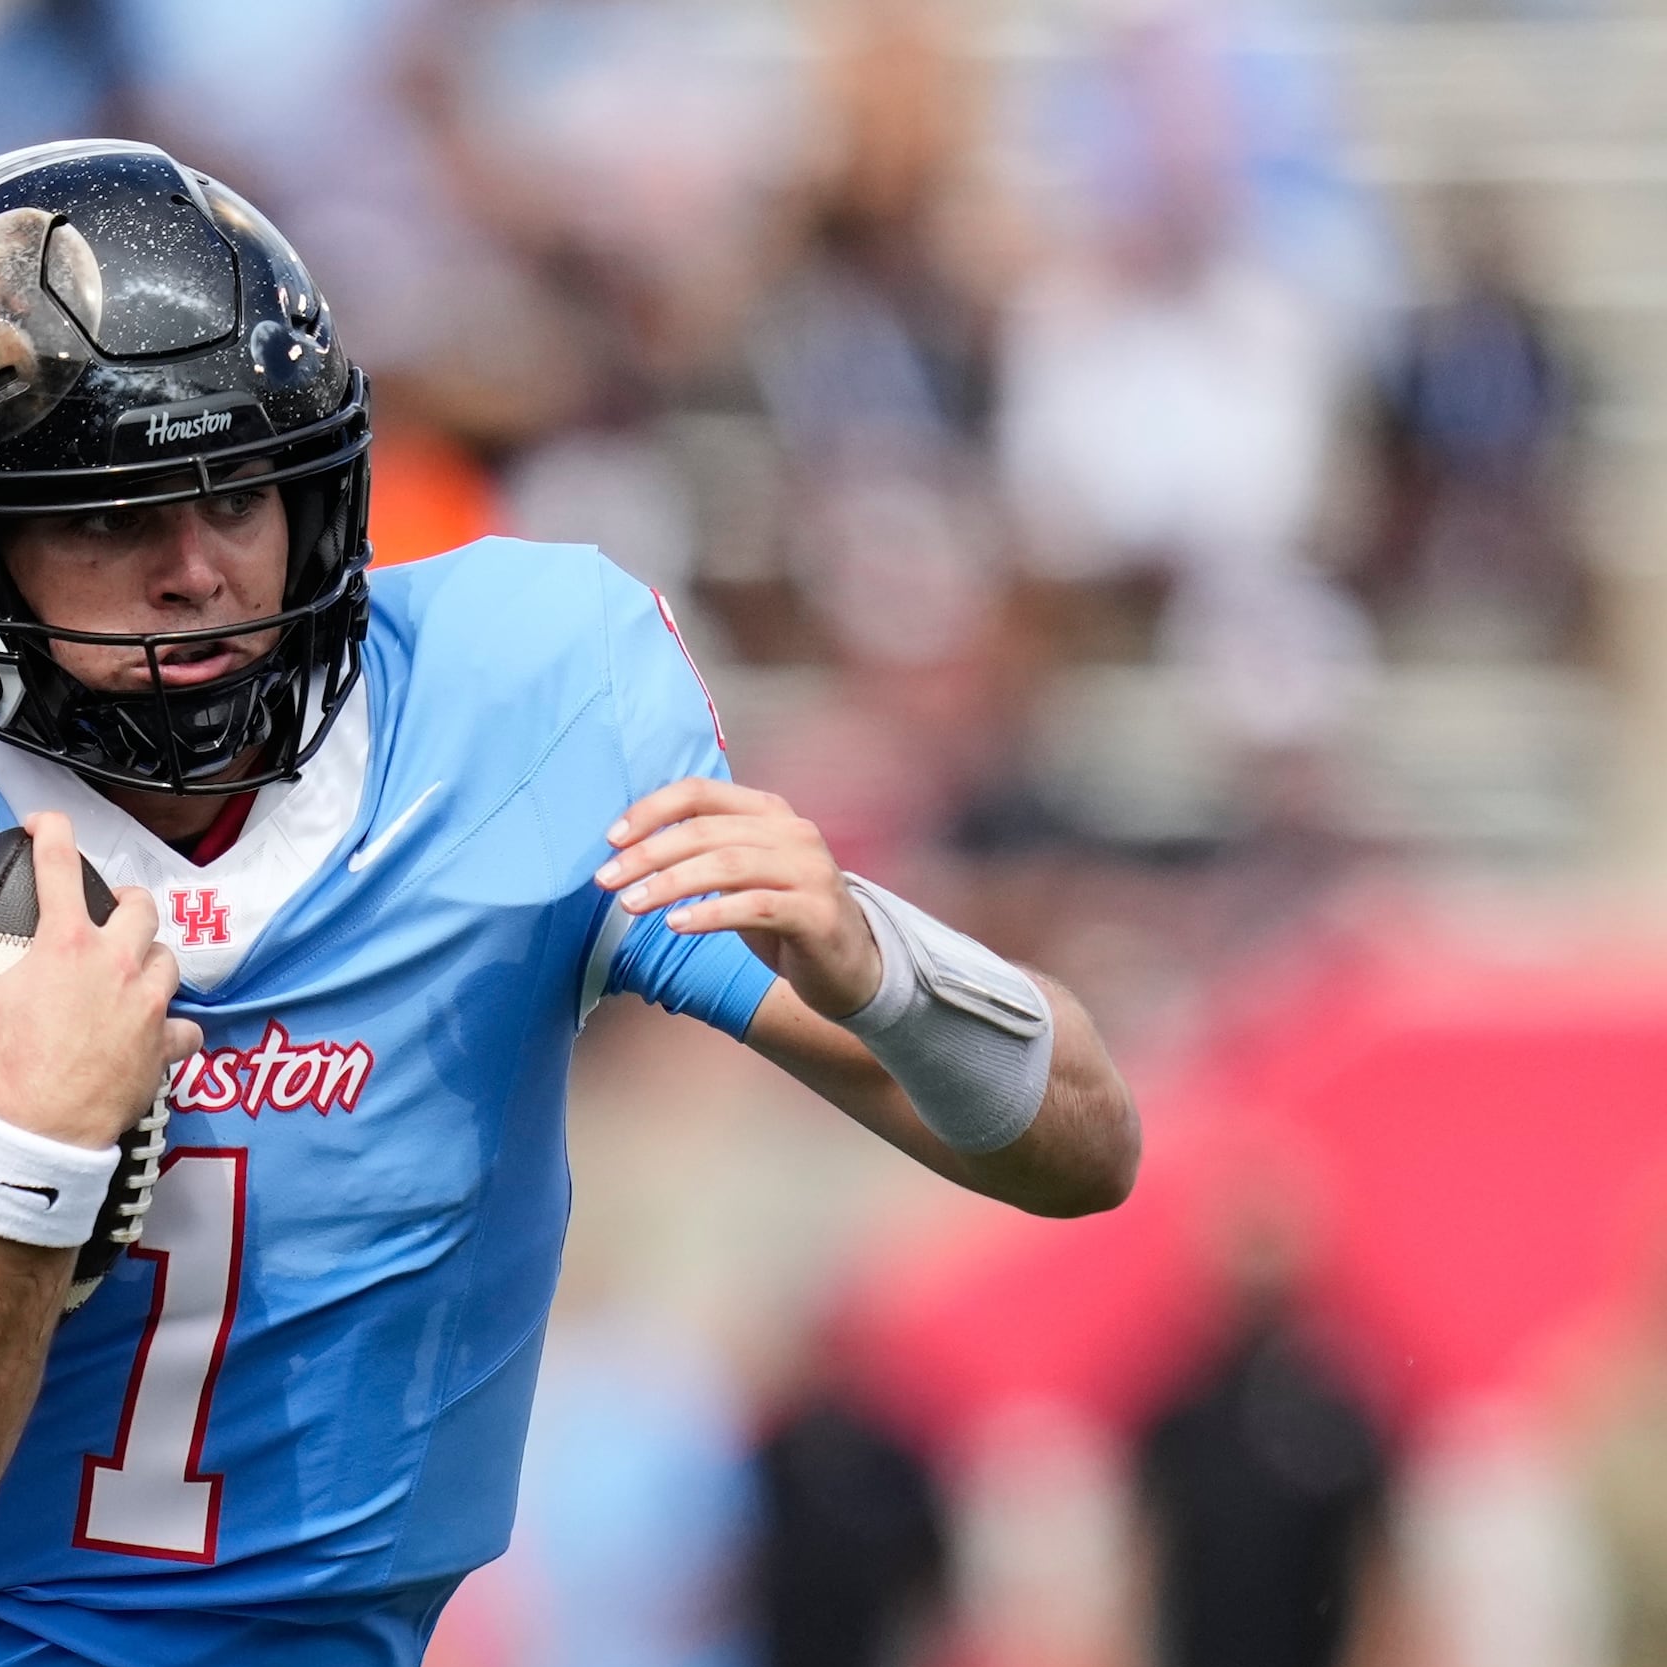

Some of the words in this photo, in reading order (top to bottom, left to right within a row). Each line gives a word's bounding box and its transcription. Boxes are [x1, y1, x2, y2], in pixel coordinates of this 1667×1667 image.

[145, 408, 233, 447] Houston
[168, 887, 231, 947] UH
[168, 1018, 375, 1120] uston
[71, 1145, 249, 1565] 1
